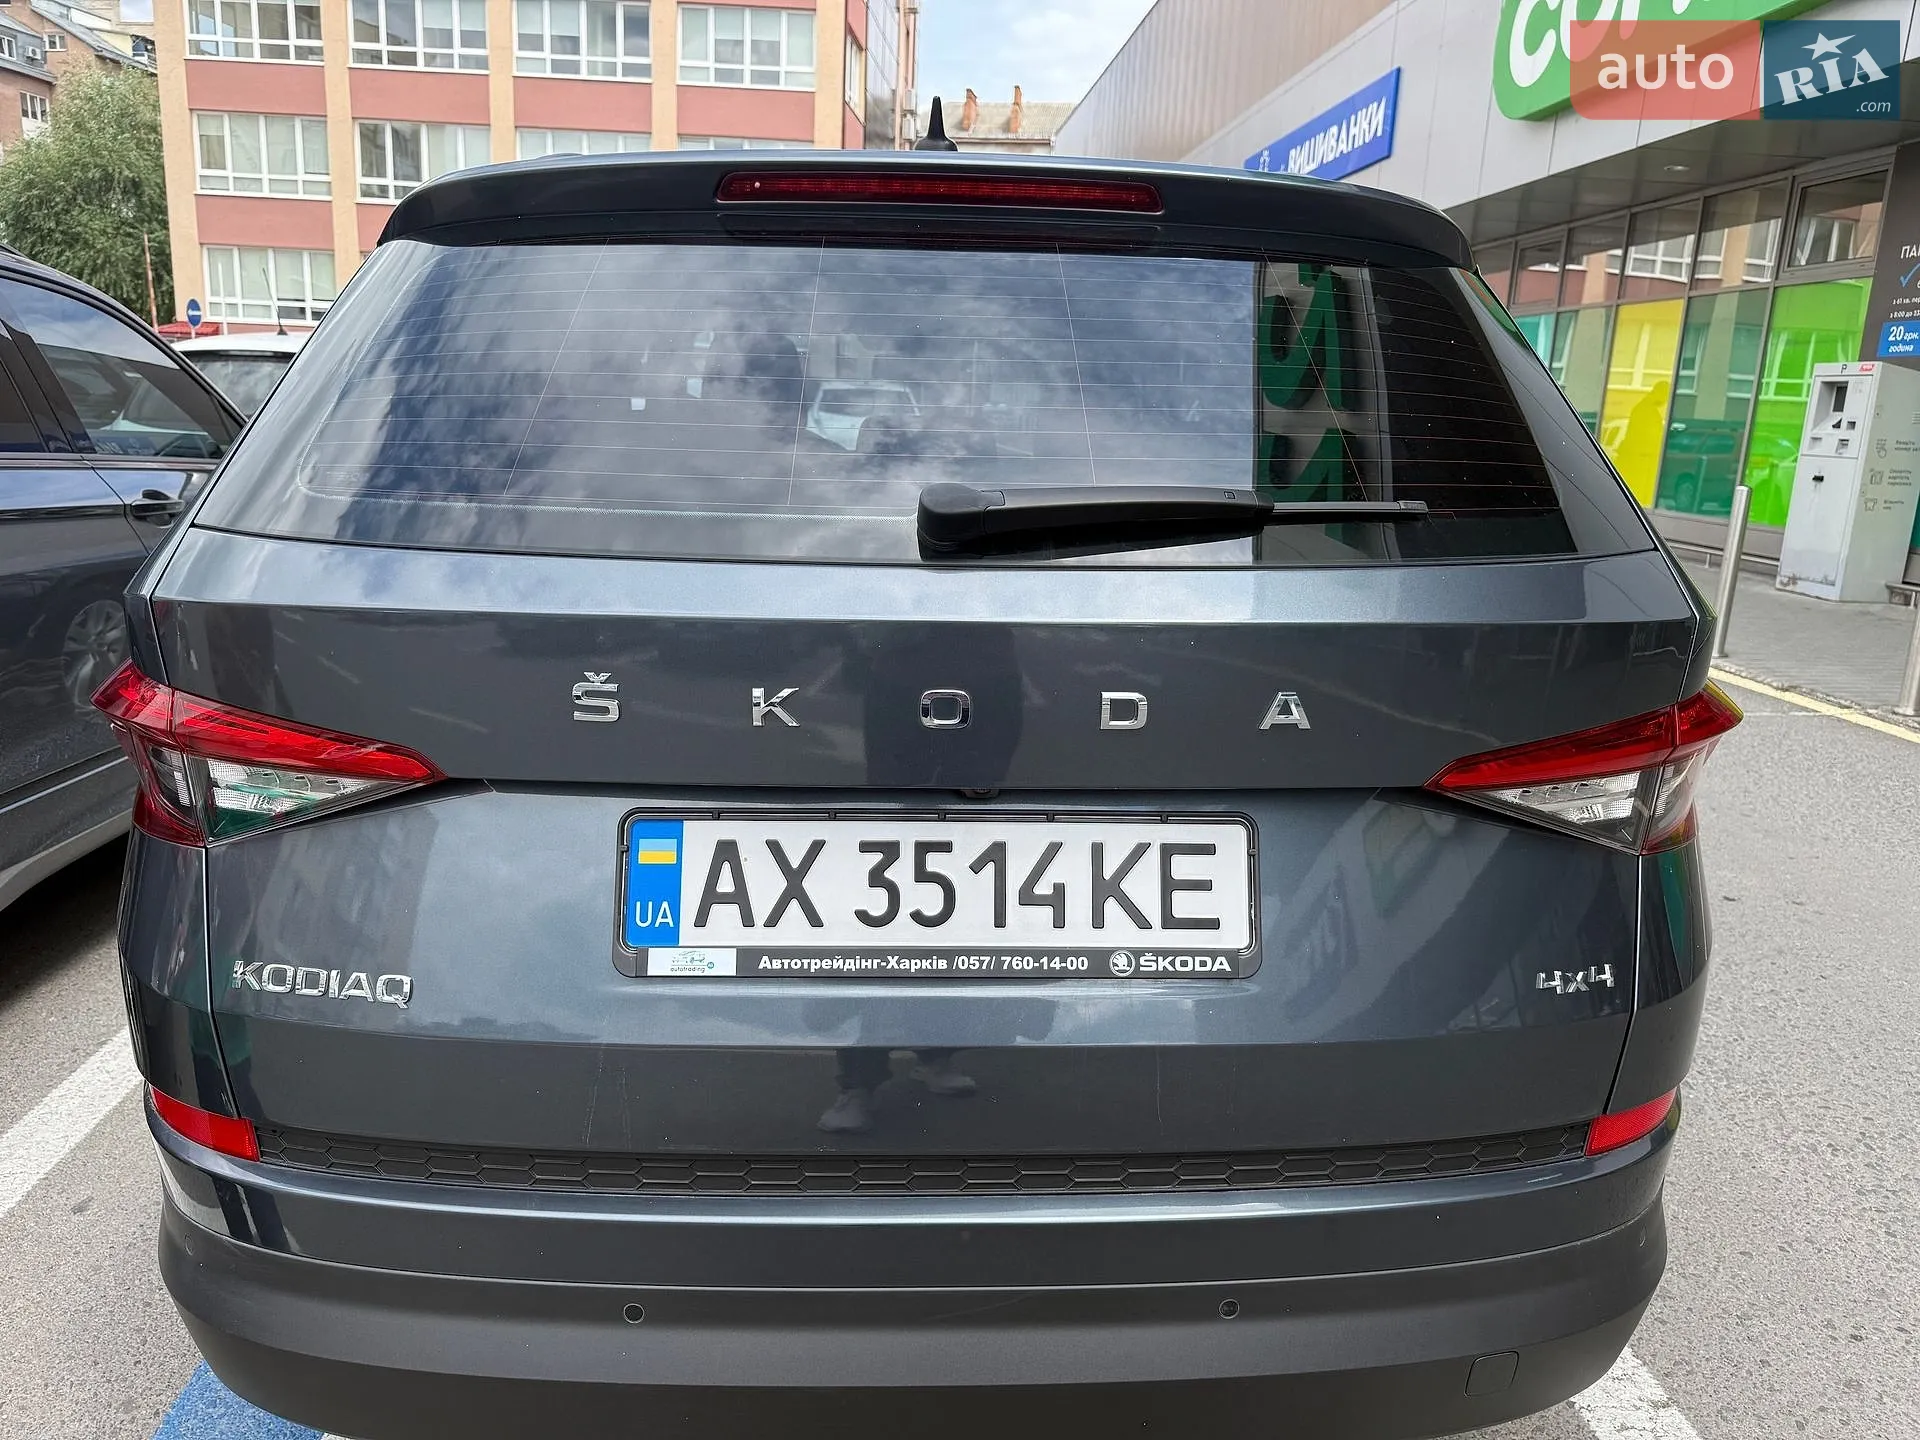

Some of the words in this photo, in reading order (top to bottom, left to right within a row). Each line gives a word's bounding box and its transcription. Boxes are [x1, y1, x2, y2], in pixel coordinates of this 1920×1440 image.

[1287, 96, 1387, 175] ВИШИВАНКИ
[1888, 325, 1905, 341] 20
[572, 671, 1311, 731] ŠKODA
[635, 901, 674, 928] UA
[693, 839, 827, 928] AX
[854, 839, 1066, 929] 3514
[1092, 841, 1221, 931] KE
[231, 960, 413, 1009] KODIAQ
[757, 955, 948, 973] Автотрейдінг-Харків
[951, 955, 996, 970] /057/
[1000, 955, 1089, 971] 760-14-00
[1139, 952, 1232, 972] ŠKODA
